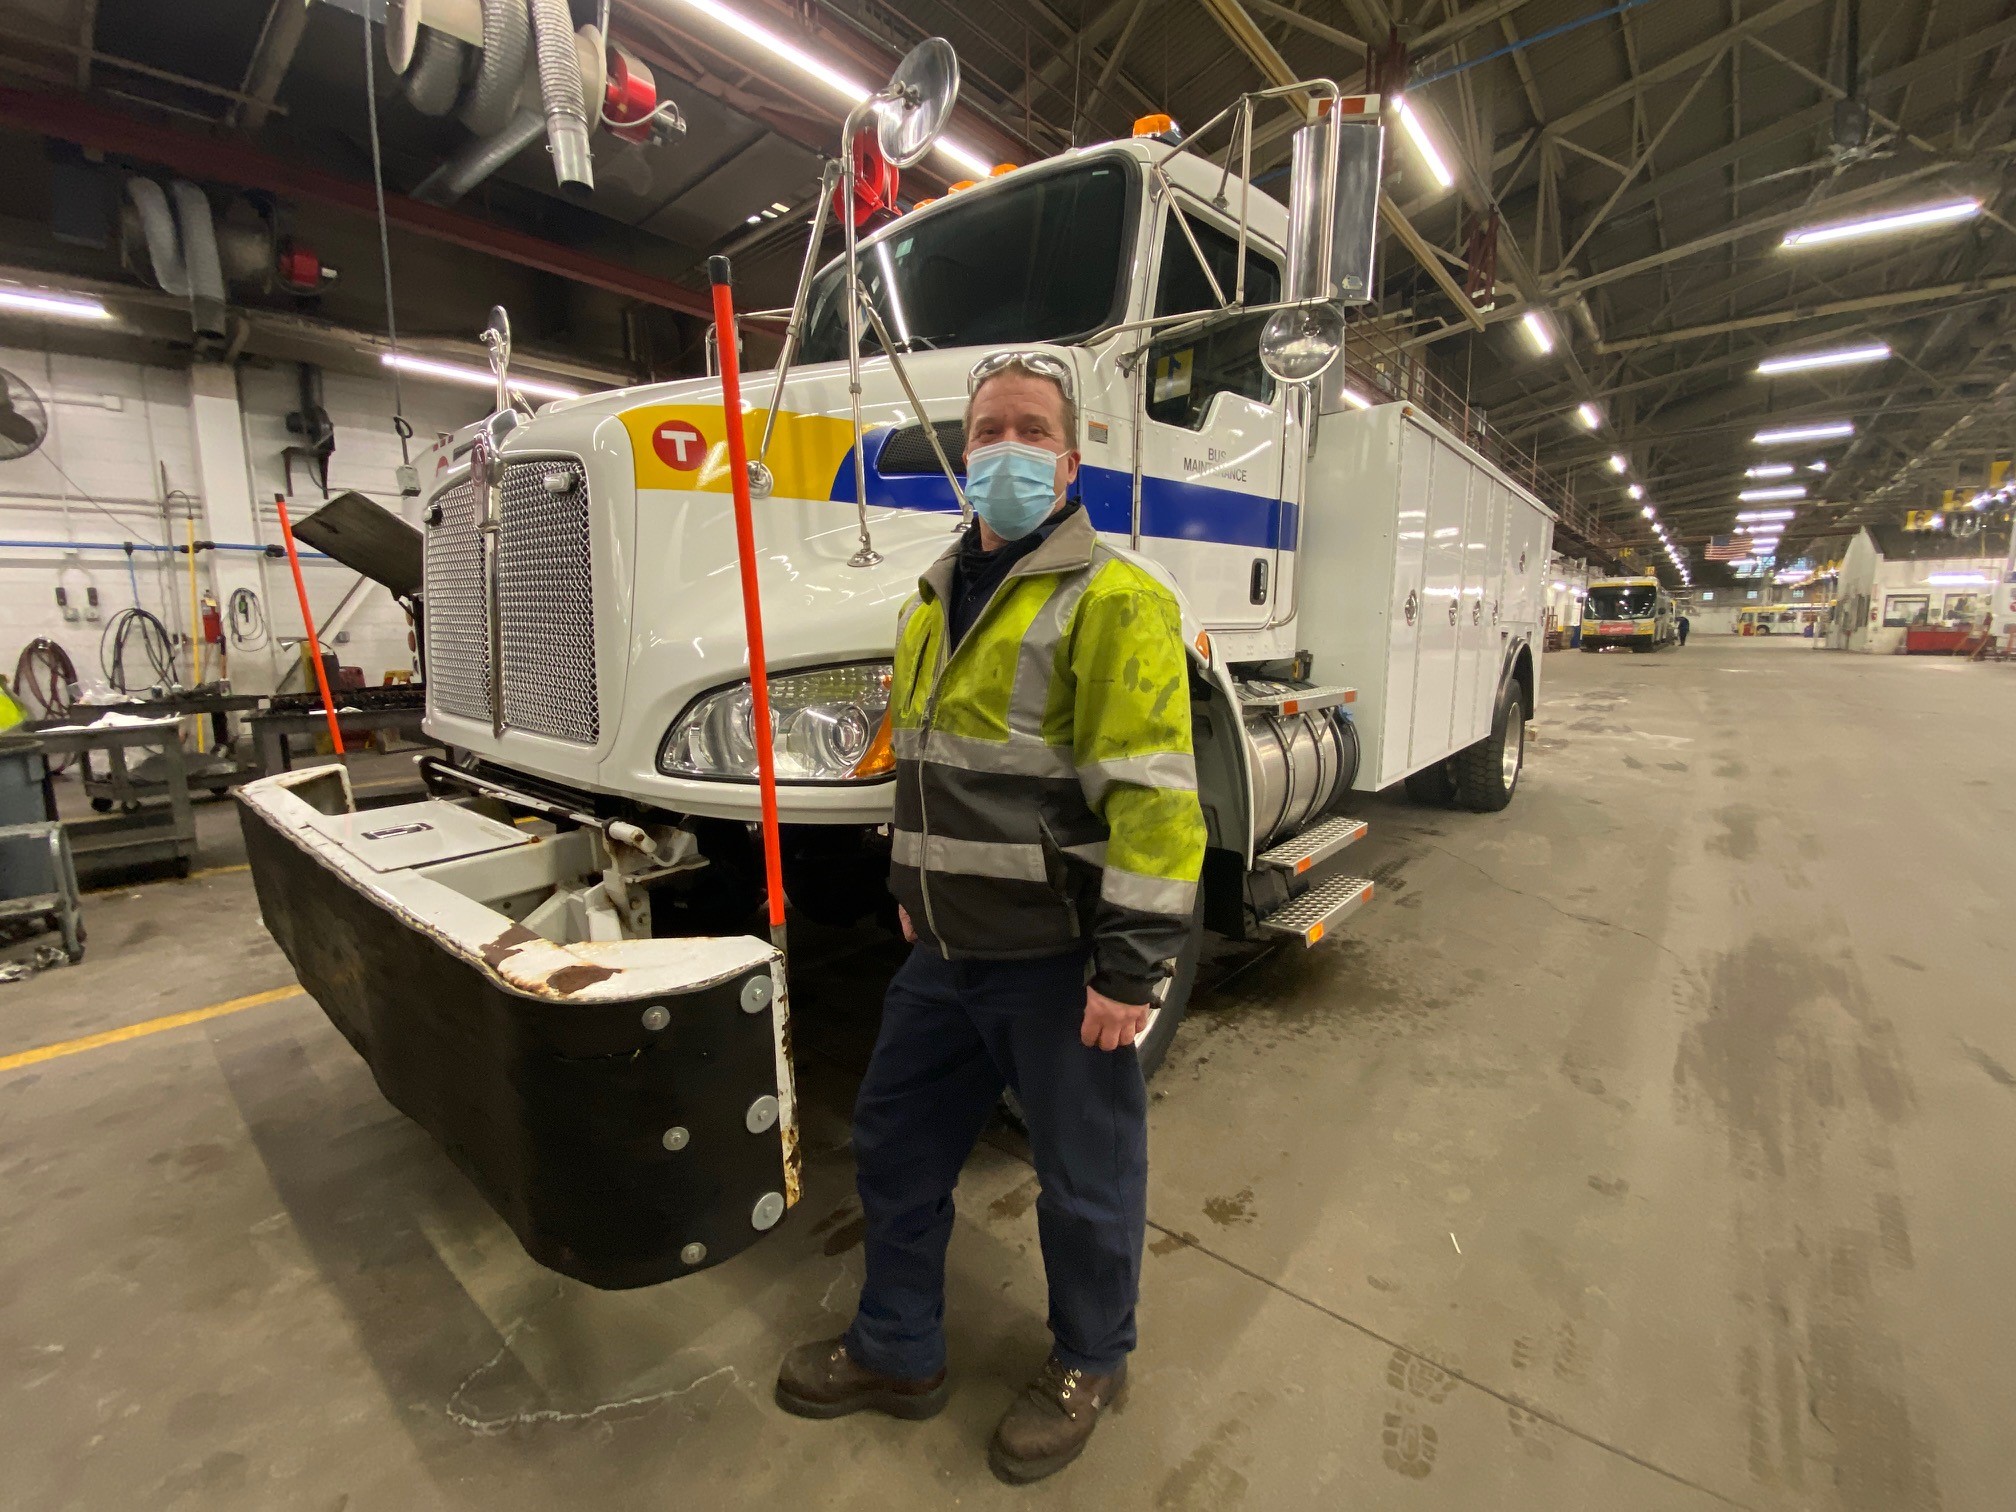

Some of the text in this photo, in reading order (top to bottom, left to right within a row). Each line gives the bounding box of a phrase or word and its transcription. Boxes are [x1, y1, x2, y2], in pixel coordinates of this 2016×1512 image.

[660, 429, 698, 462] T
[1208, 448, 1227, 463] BUS
[1183, 457, 1247, 482] MAINTANCE
